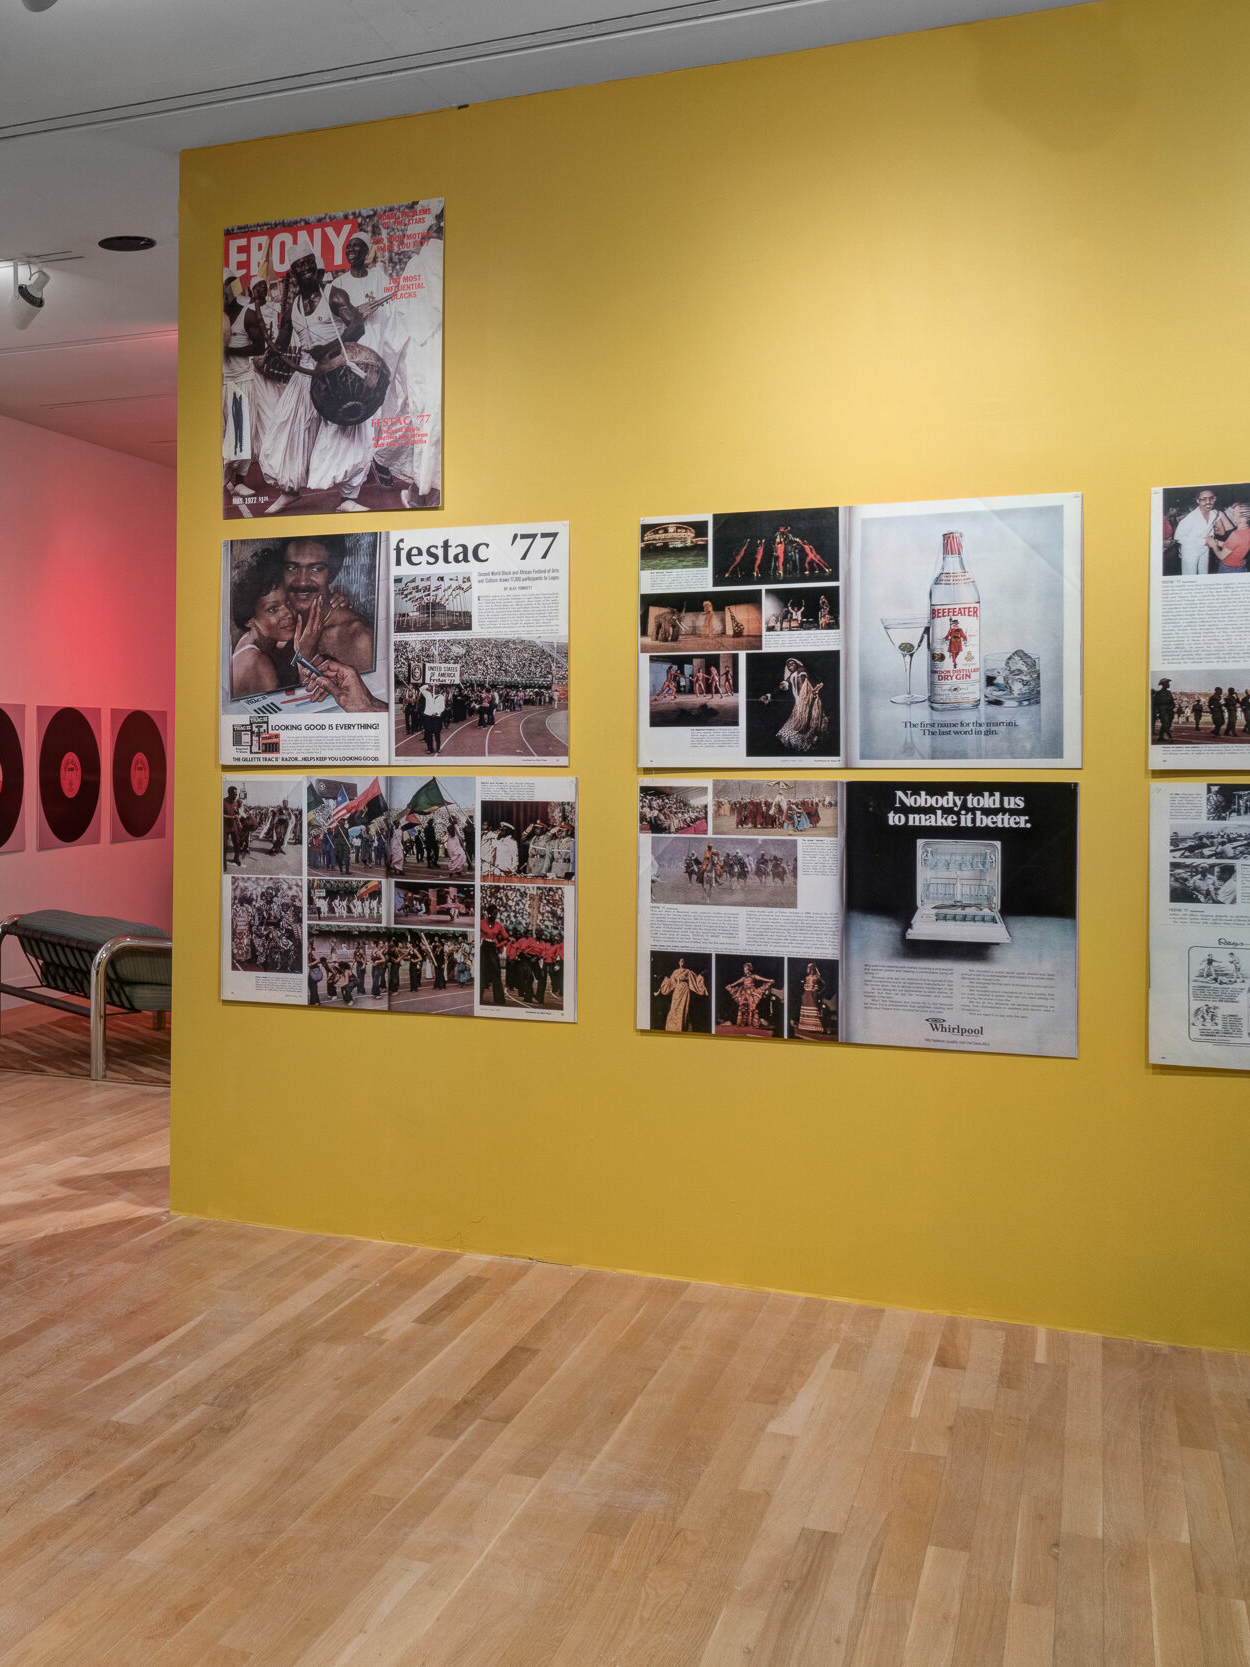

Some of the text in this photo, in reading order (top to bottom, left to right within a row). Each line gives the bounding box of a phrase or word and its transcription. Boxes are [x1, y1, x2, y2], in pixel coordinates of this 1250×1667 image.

[401, 208, 431, 218] PROBLEMS
[408, 217, 425, 225] STARS
[229, 224, 352, 276] EBONY
[397, 242, 410, 250] YOU
[403, 275, 421, 284] MOST
[384, 283, 425, 293] INFLUENTIAL
[392, 291, 417, 301] BLACKS
[371, 416, 411, 428] FESTAC
[245, 497, 257, 505] 1977
[394, 531, 560, 567] festac '77
[932, 607, 979, 620] BEEFEATER
[902, 721, 919, 729] The
[960, 720, 971, 728] for
[973, 720, 985, 728] the
[895, 791, 1025, 811] Nobody told us
[888, 810, 1032, 828] to make it better.
[929, 1023, 984, 1036] Whirlpool
